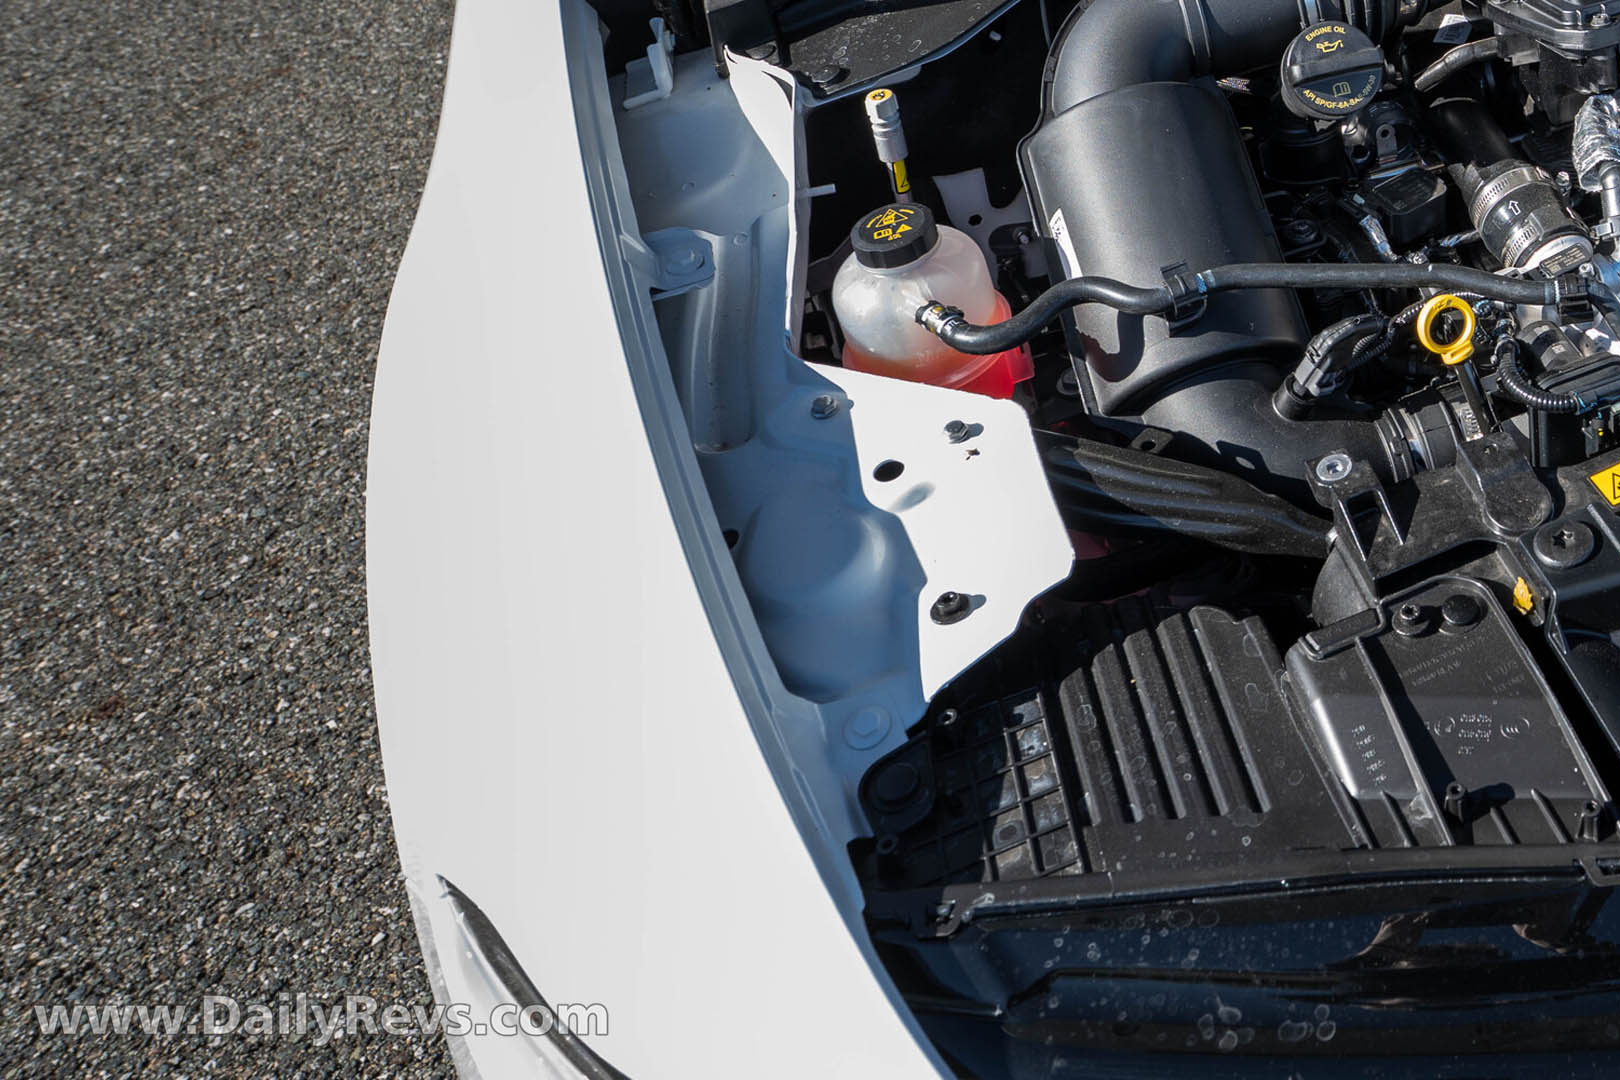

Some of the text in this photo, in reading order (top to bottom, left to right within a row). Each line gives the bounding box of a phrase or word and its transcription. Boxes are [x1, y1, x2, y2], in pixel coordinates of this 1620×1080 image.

[1305, 25, 1345, 41] ENGINE OIL
[1303, 89, 1316, 101] API
